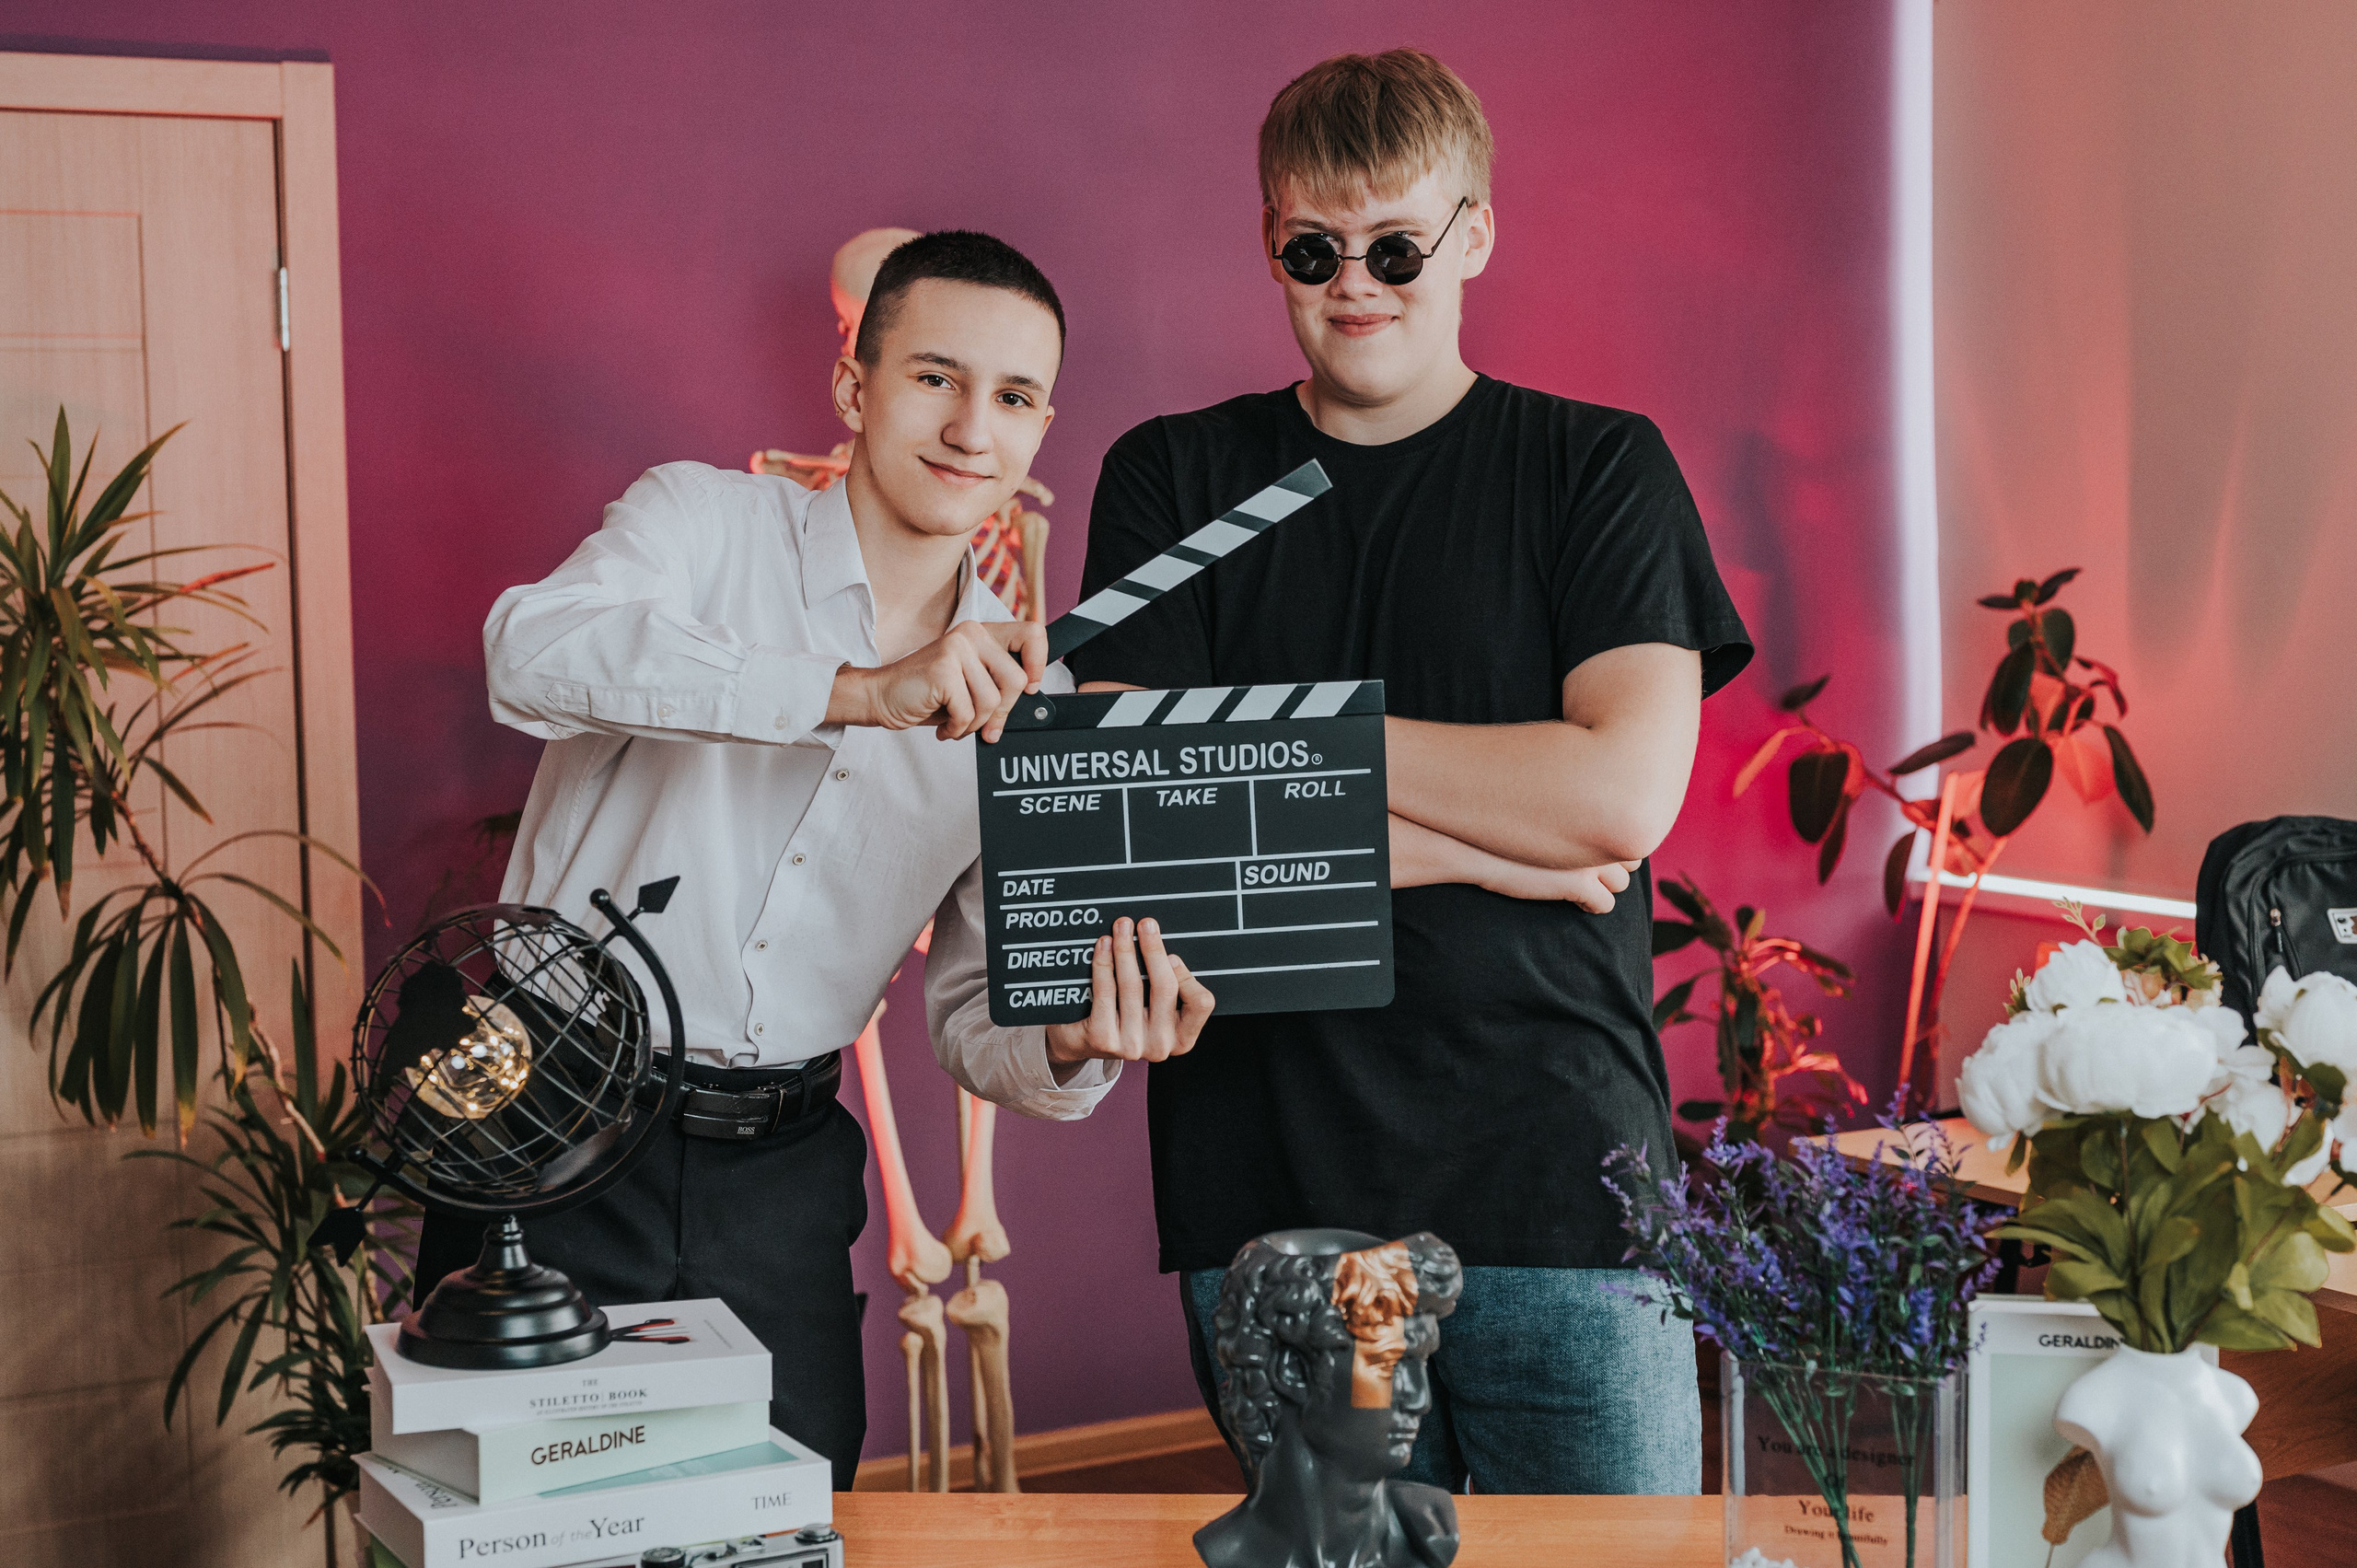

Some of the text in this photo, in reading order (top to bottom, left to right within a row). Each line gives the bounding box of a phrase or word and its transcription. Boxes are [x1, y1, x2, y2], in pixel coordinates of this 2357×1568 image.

[1000, 749, 1170, 784] UNIVERSAL
[1156, 787, 1218, 807] TAKE
[1284, 781, 1346, 799] ROLL
[1019, 794, 1102, 815] SCENE
[1244, 861, 1330, 886] SOUND
[1003, 878, 1055, 897] DATE
[1005, 908, 1103, 929] PROD.CO.
[1007, 947, 1095, 970] DIRECTO
[2038, 1334, 2126, 1349] GERALDIN
[528, 1393, 599, 1409] STILETTO
[609, 1388, 647, 1400] BOOK
[531, 1425, 645, 1465] GERALDINE
[1758, 1435, 1793, 1455] You
[750, 1492, 793, 1510] TIME
[1798, 1499, 1840, 1518] You
[459, 1531, 547, 1560] Person
[590, 1517, 645, 1539] Year
